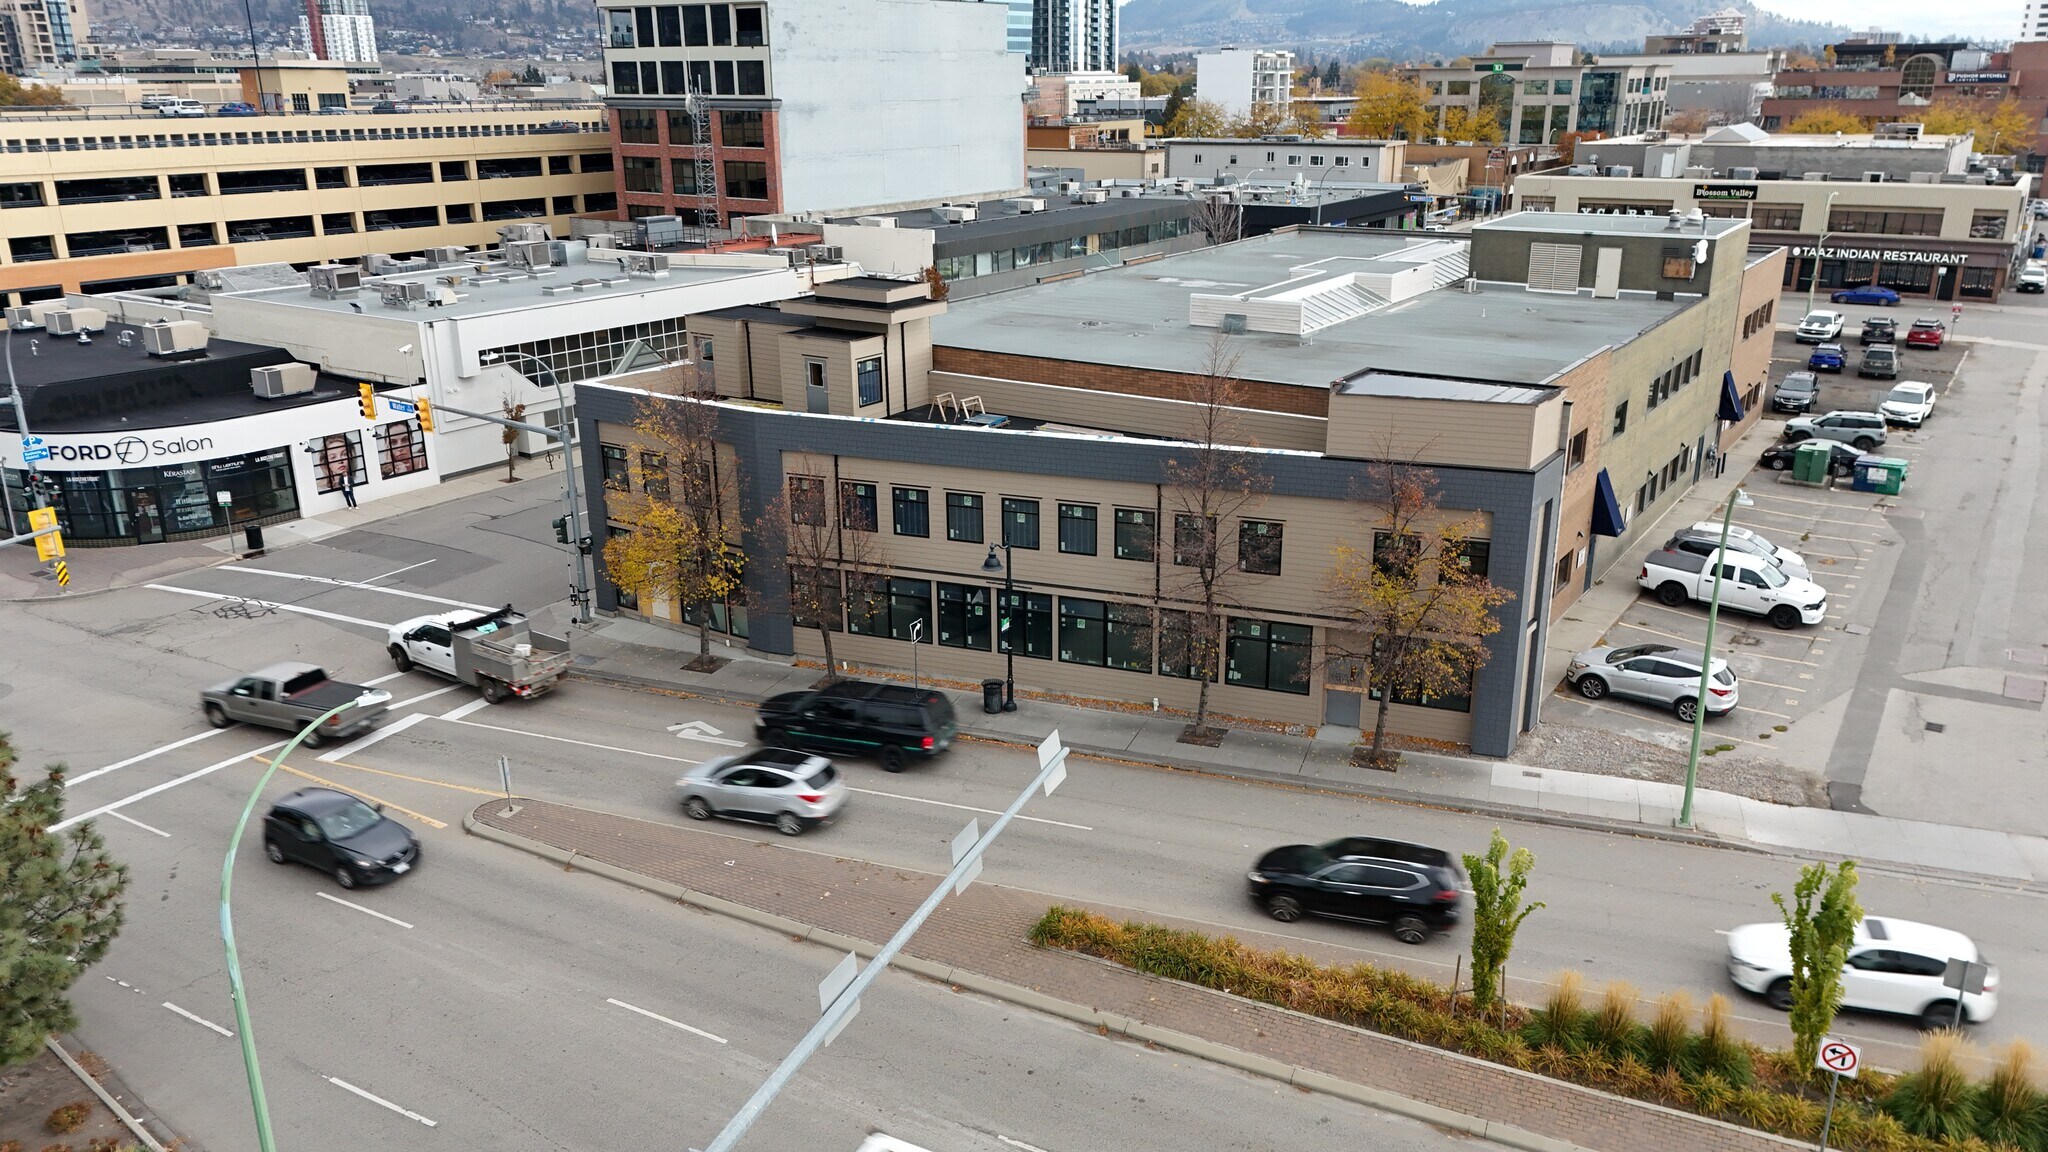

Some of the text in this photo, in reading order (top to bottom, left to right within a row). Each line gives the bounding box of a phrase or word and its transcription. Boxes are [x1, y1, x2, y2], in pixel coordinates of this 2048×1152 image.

[1696, 189, 1754, 198] Blossom Valley
[1802, 247, 1968, 264] TAAZ INDIAN RESTAURANT
[48, 445, 111, 461] FORD
[152, 436, 214, 456] Salon
